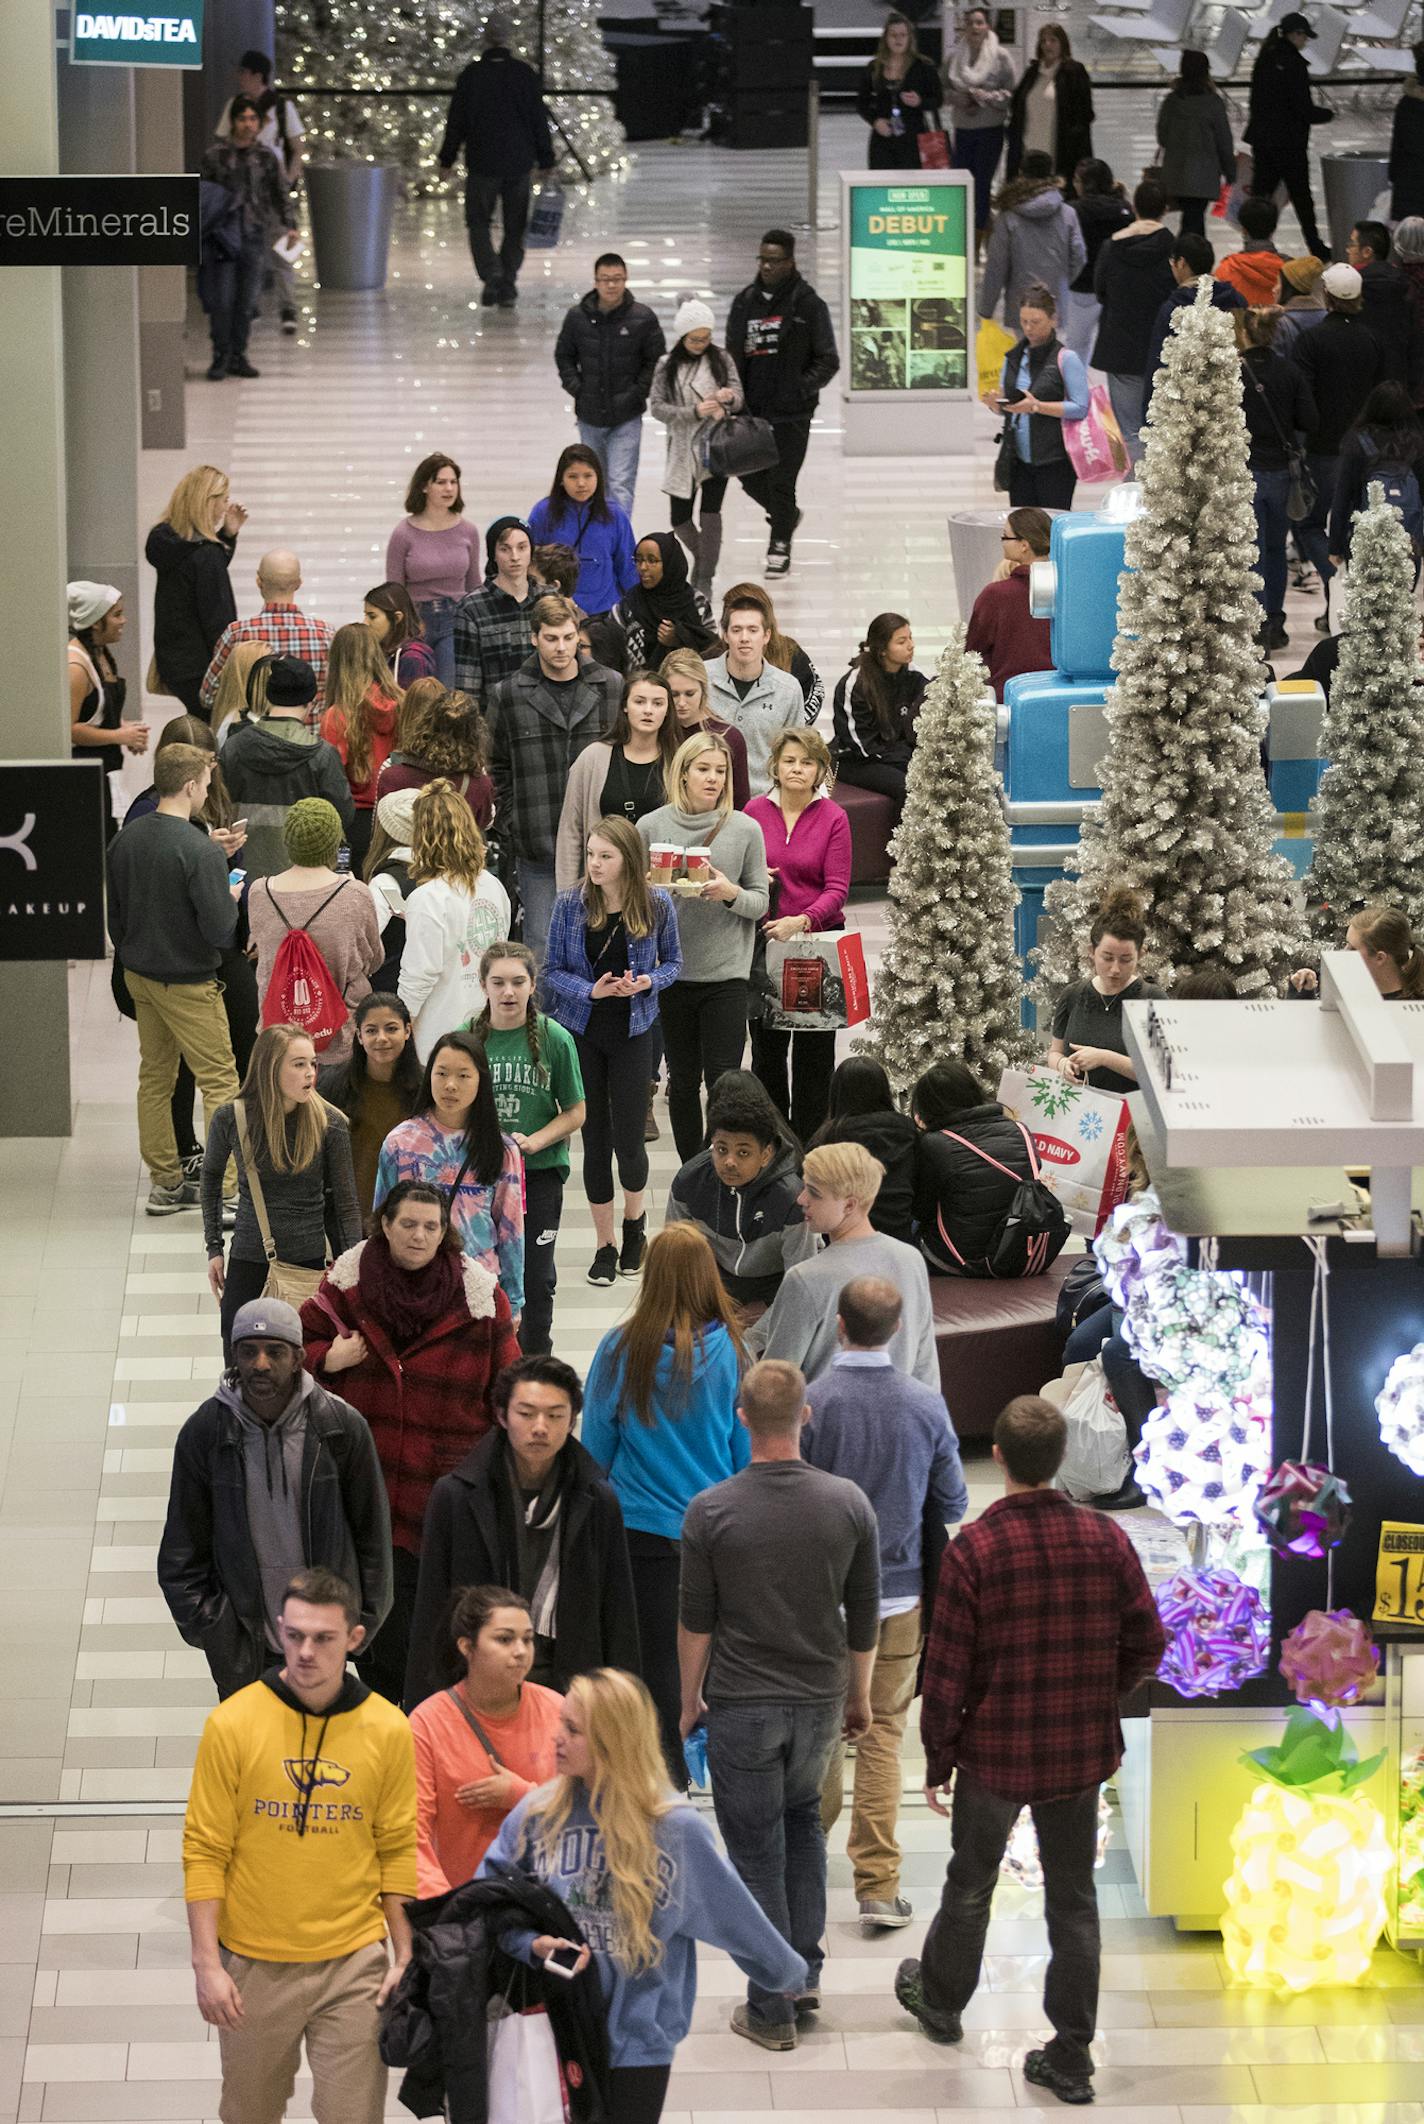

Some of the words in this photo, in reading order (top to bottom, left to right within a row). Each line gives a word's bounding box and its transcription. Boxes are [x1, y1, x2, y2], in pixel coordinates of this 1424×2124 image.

[76, 14, 197, 43] DAVIDsTEA
[868, 215, 949, 234] DEBUT
[0, 902, 86, 915] AKEUP
[312, 1027, 332, 1039] .edu
[505, 1062, 551, 1092] DAKOA
[1047, 1144, 1075, 1161] NAVY
[254, 1798, 364, 1821] POINTERS
